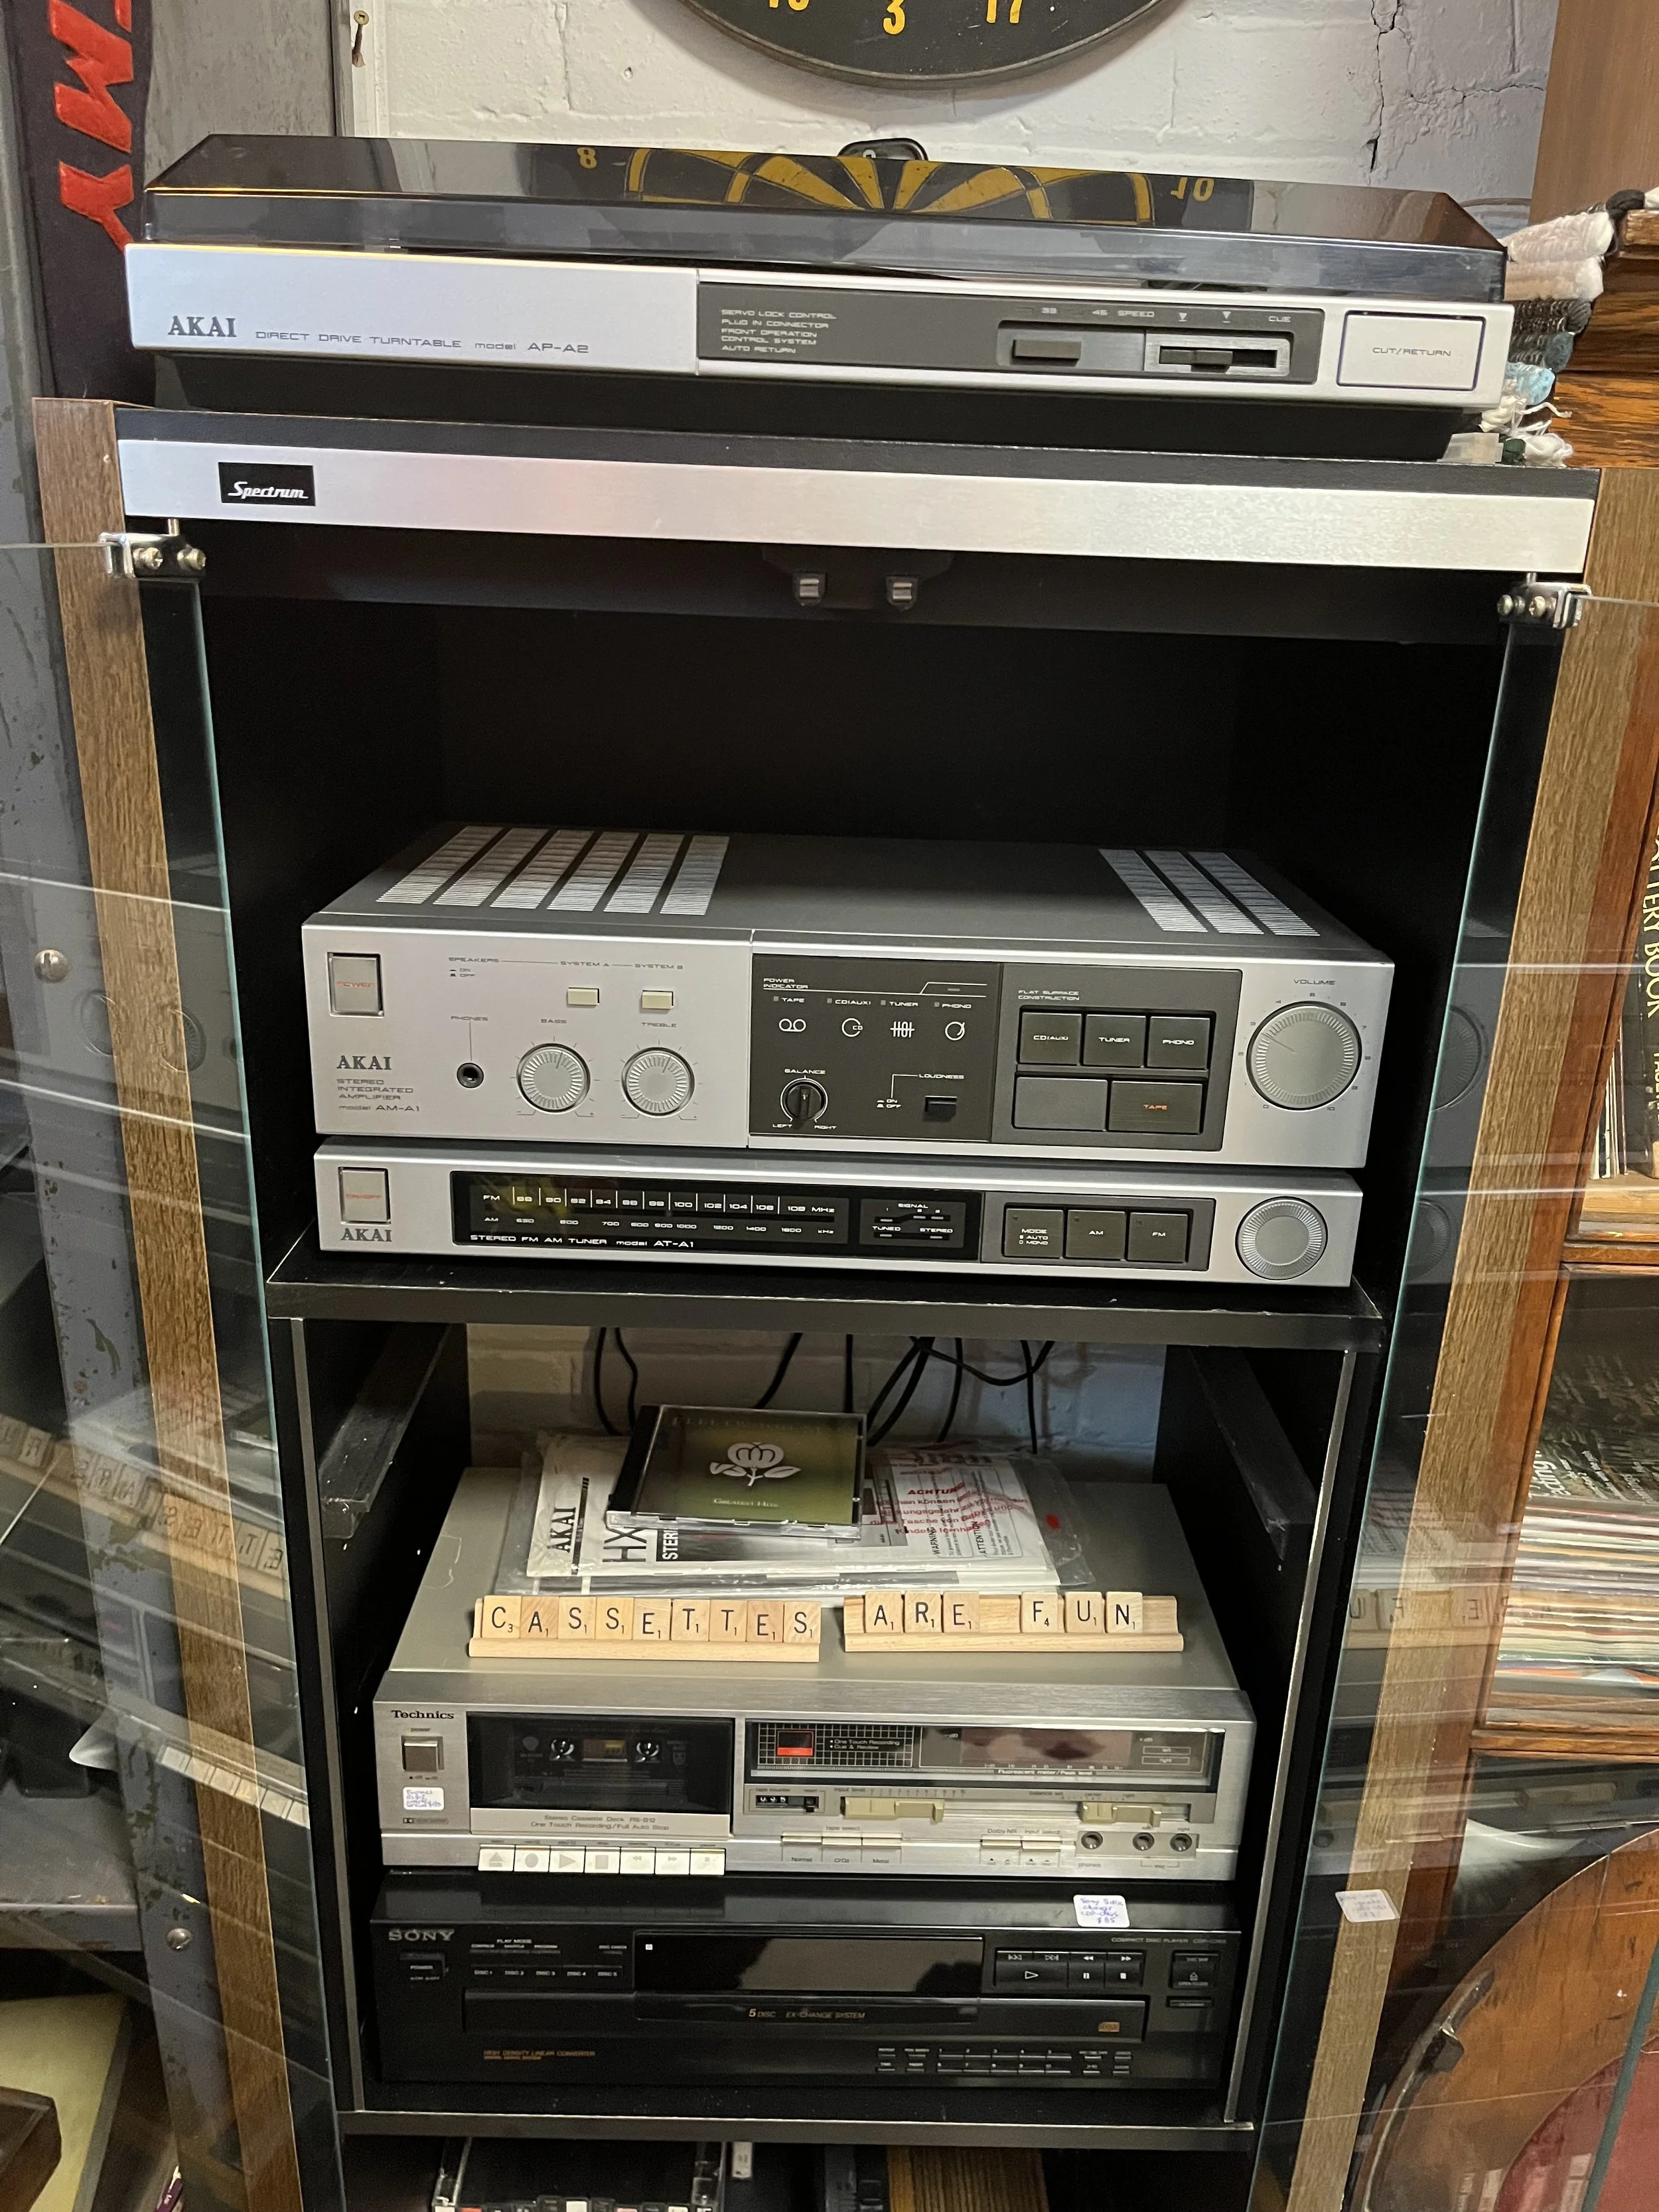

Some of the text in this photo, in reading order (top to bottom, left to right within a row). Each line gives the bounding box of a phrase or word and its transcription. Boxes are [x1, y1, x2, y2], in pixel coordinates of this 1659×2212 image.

[168, 315, 237, 337] AKAI
[255, 331, 309, 341] DIRECT
[319, 334, 361, 343] DRIVE
[370, 336, 461, 348] TURNTABLE
[527, 342, 589, 354] AP-A2
[1372, 347, 1451, 356] CUT/RETURN
[228, 481, 309, 499] Spectrum
[336, 1055, 392, 1070] AKAI
[340, 1228, 392, 1242] AKAI
[547, 1507, 576, 1553] AKAI
[662, 1528, 679, 1560] STER
[392, 1710, 455, 1719] Technics
[388, 1929, 455, 1942] SONY
